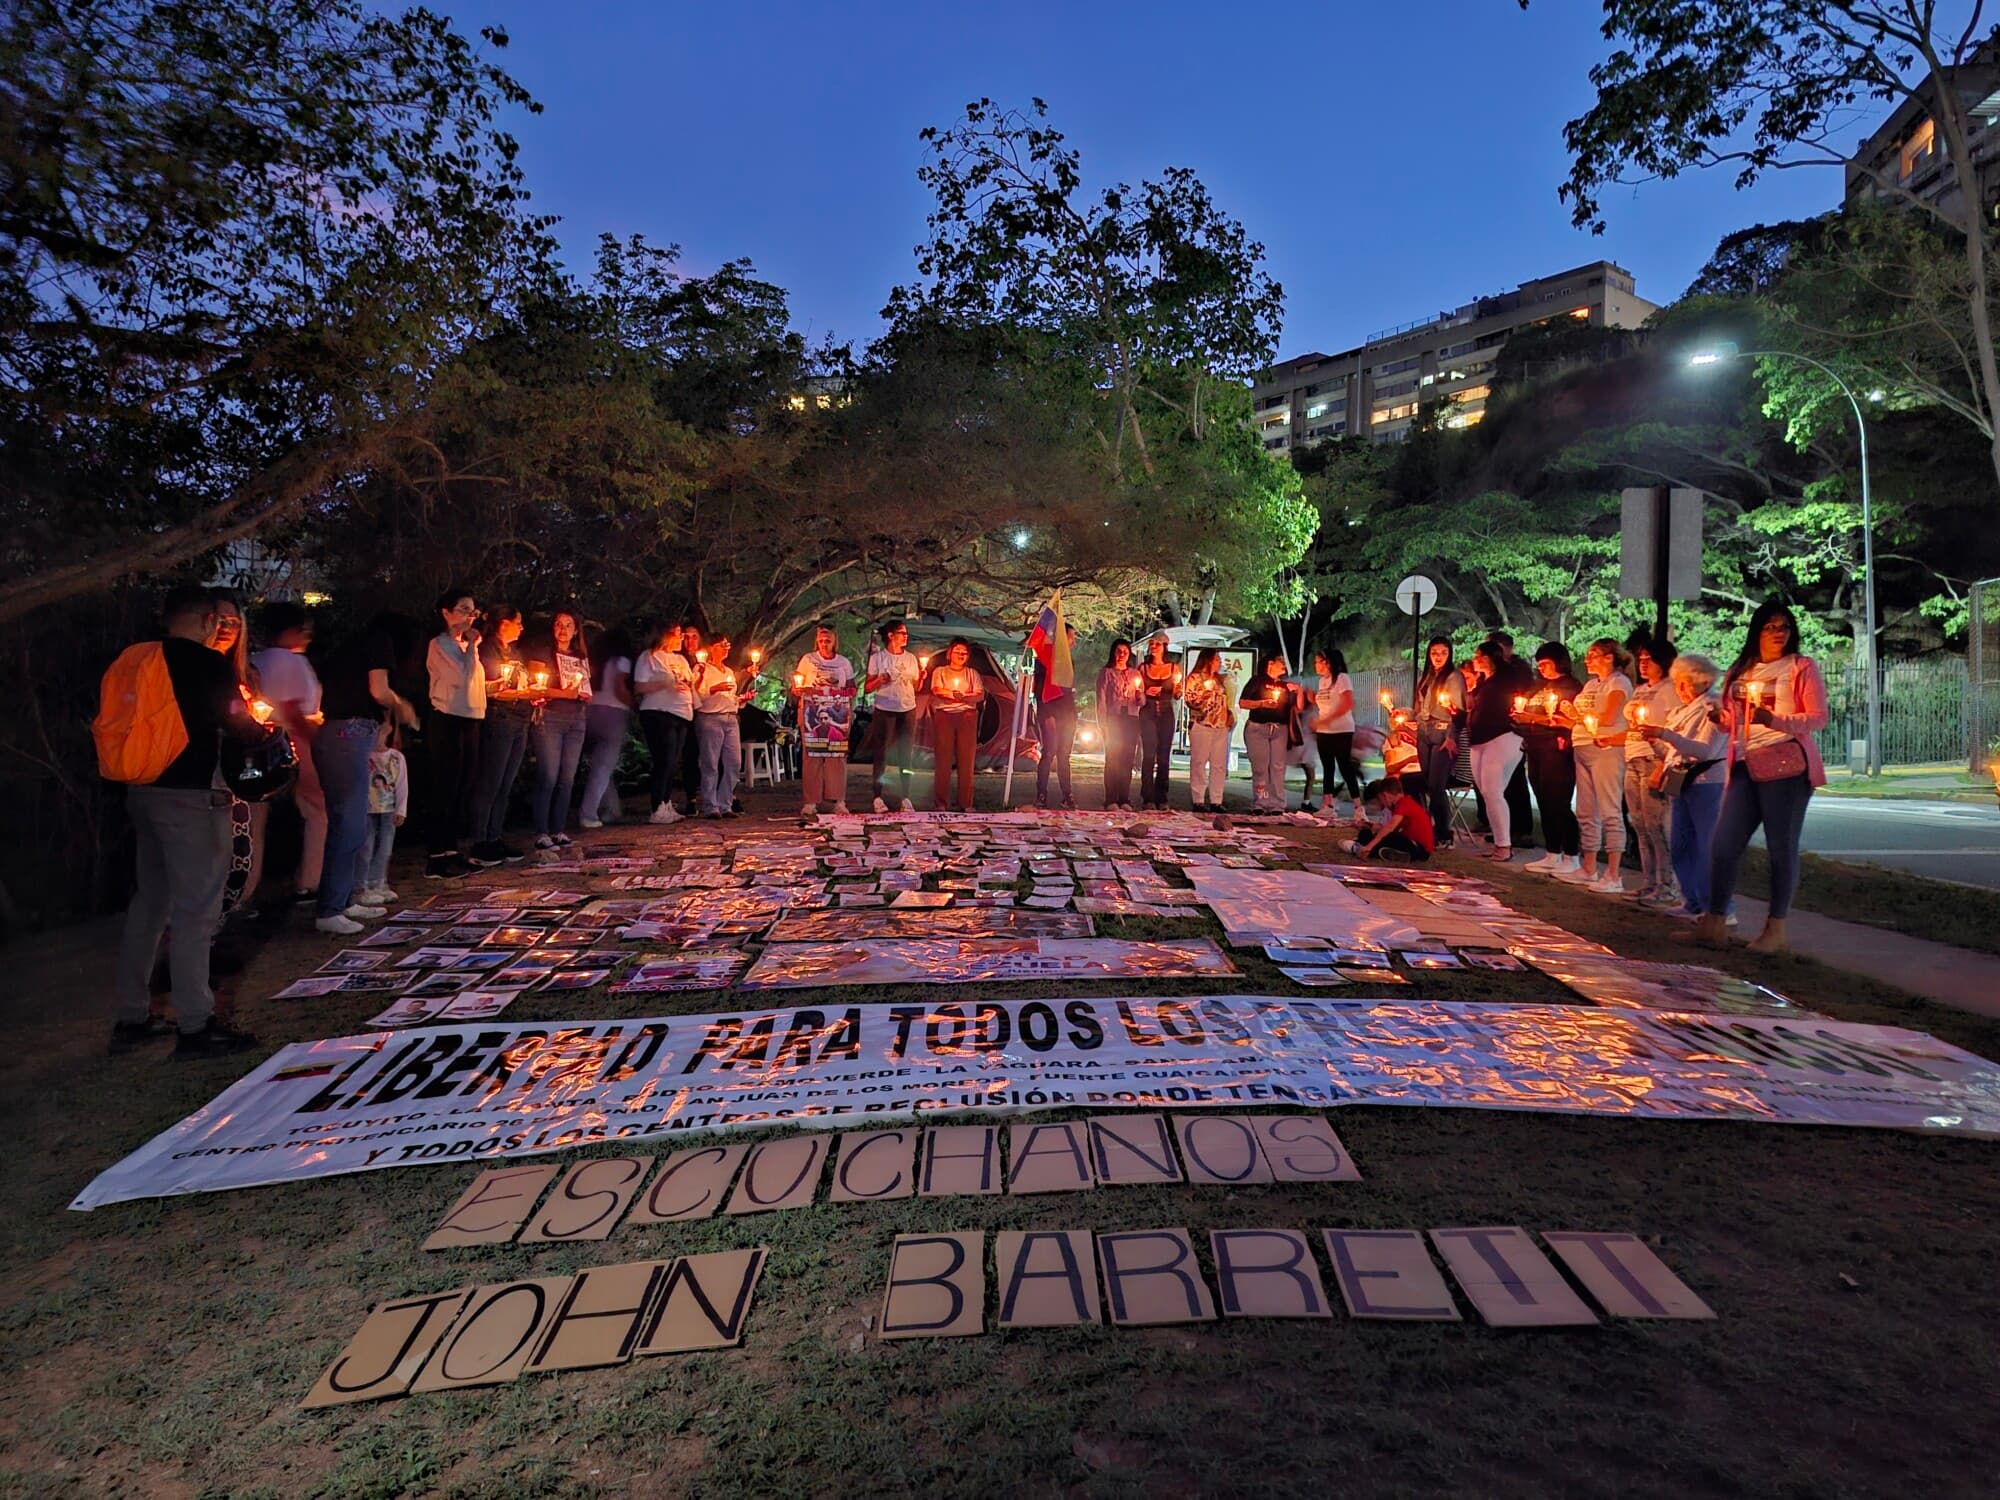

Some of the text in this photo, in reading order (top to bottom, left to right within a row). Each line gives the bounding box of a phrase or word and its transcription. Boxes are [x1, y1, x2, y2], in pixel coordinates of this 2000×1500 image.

[681, 1007, 863, 1075] PARA
[888, 1000, 1104, 1058] TODOS
[1115, 1000, 1251, 1047] LOS
[171, 1142, 278, 1160] CENTRO
[730, 1091, 800, 1103] JUAN
[806, 1089, 840, 1098] DE
[846, 1084, 895, 1096] LOS
[1029, 1072, 1127, 1082] FUERTE
[288, 1111, 427, 1136] TOCUYITO
[621, 1084, 715, 1103] RODO
[823, 1067, 913, 1082] VERDE
[935, 1066, 969, 1075] LA
[1124, 1058, 1216, 1066] SANT
[362, 1146, 394, 1166] Y
[397, 1132, 528, 1162] TODOS
[1087, 1086, 1214, 1103] DONDE
[438, 1114, 1342, 1237] ESCUCHANOS
[328, 1229, 1669, 1393] JOHN BARRETT
